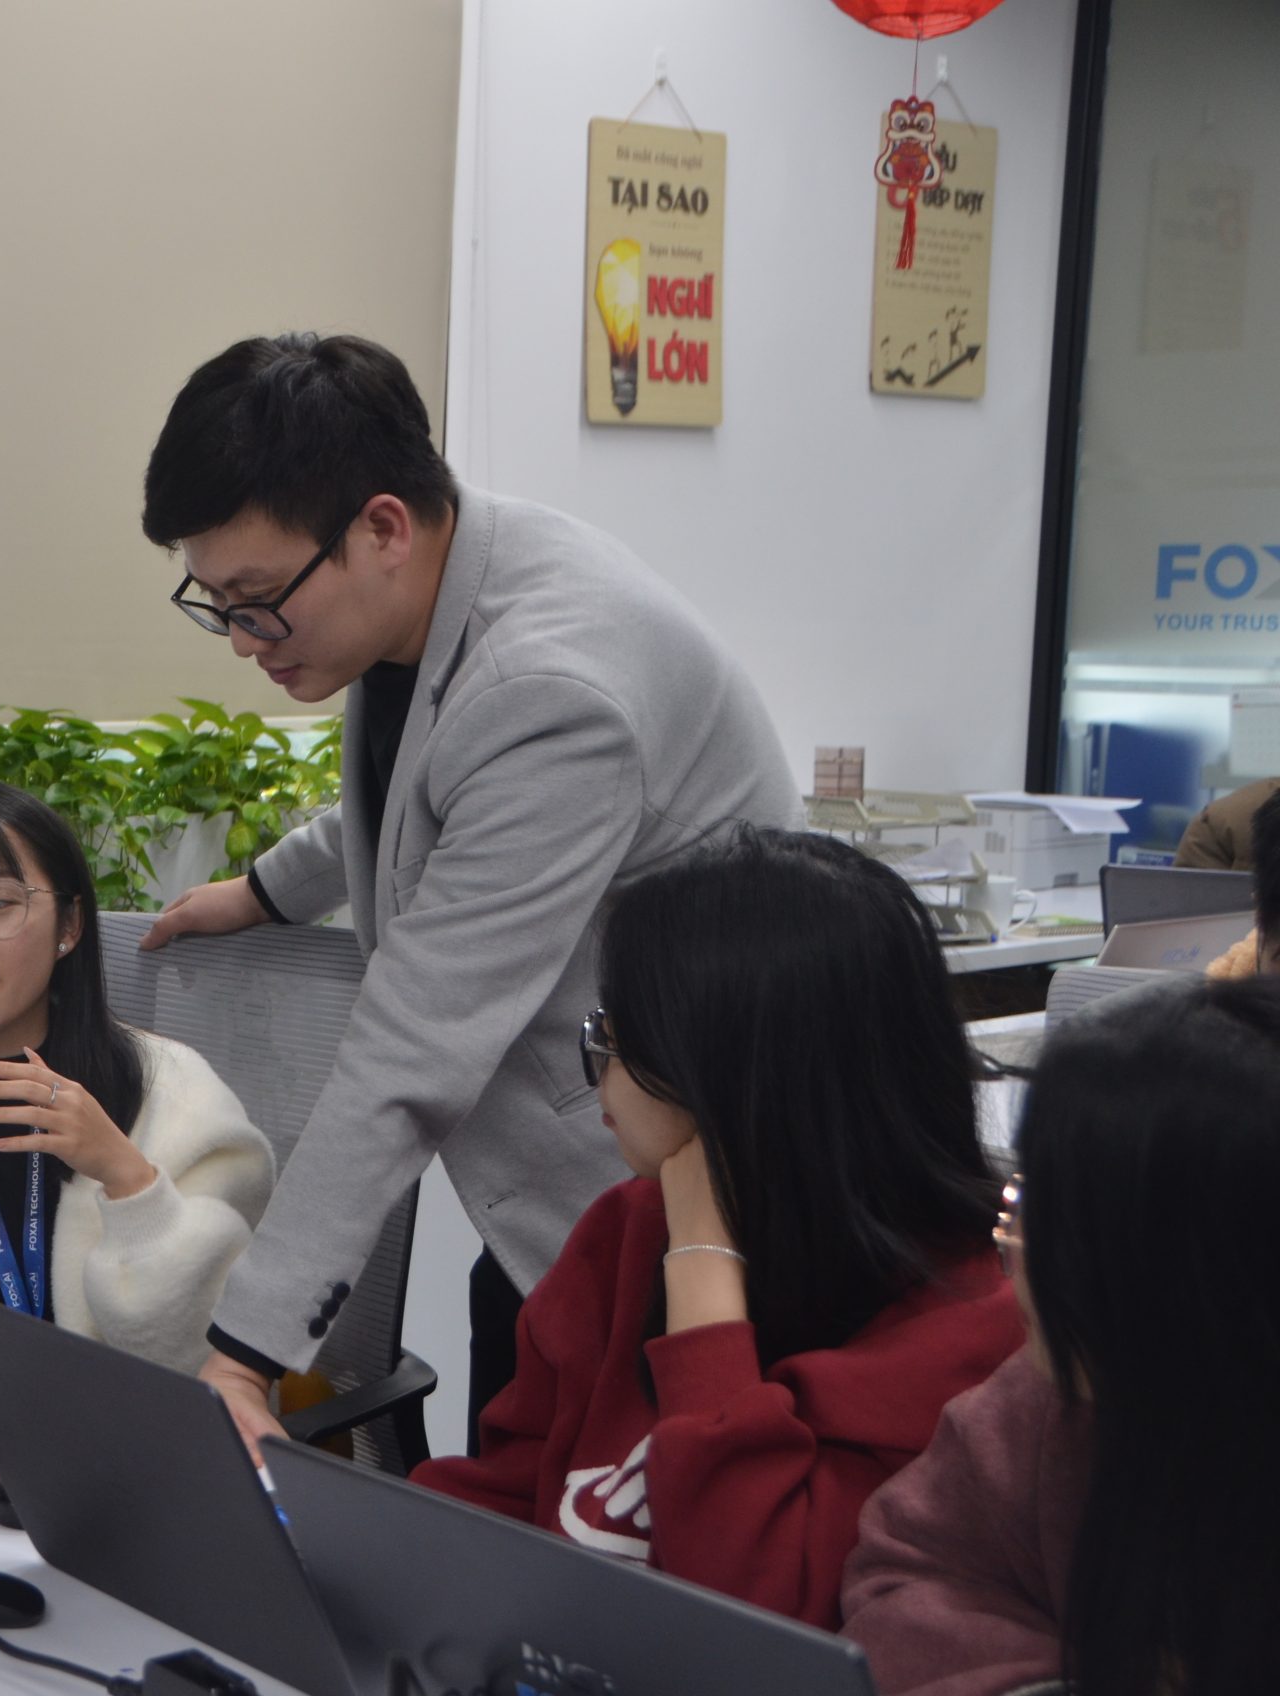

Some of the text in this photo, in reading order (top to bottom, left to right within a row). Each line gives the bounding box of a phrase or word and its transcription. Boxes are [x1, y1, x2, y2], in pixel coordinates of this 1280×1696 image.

[607, 176, 709, 216] TẠI SAO
[647, 329, 709, 384] LỚN
[1154, 612, 1214, 632] YOUR
[29, 1151, 40, 1251] FOXAI TECHNOLOG
